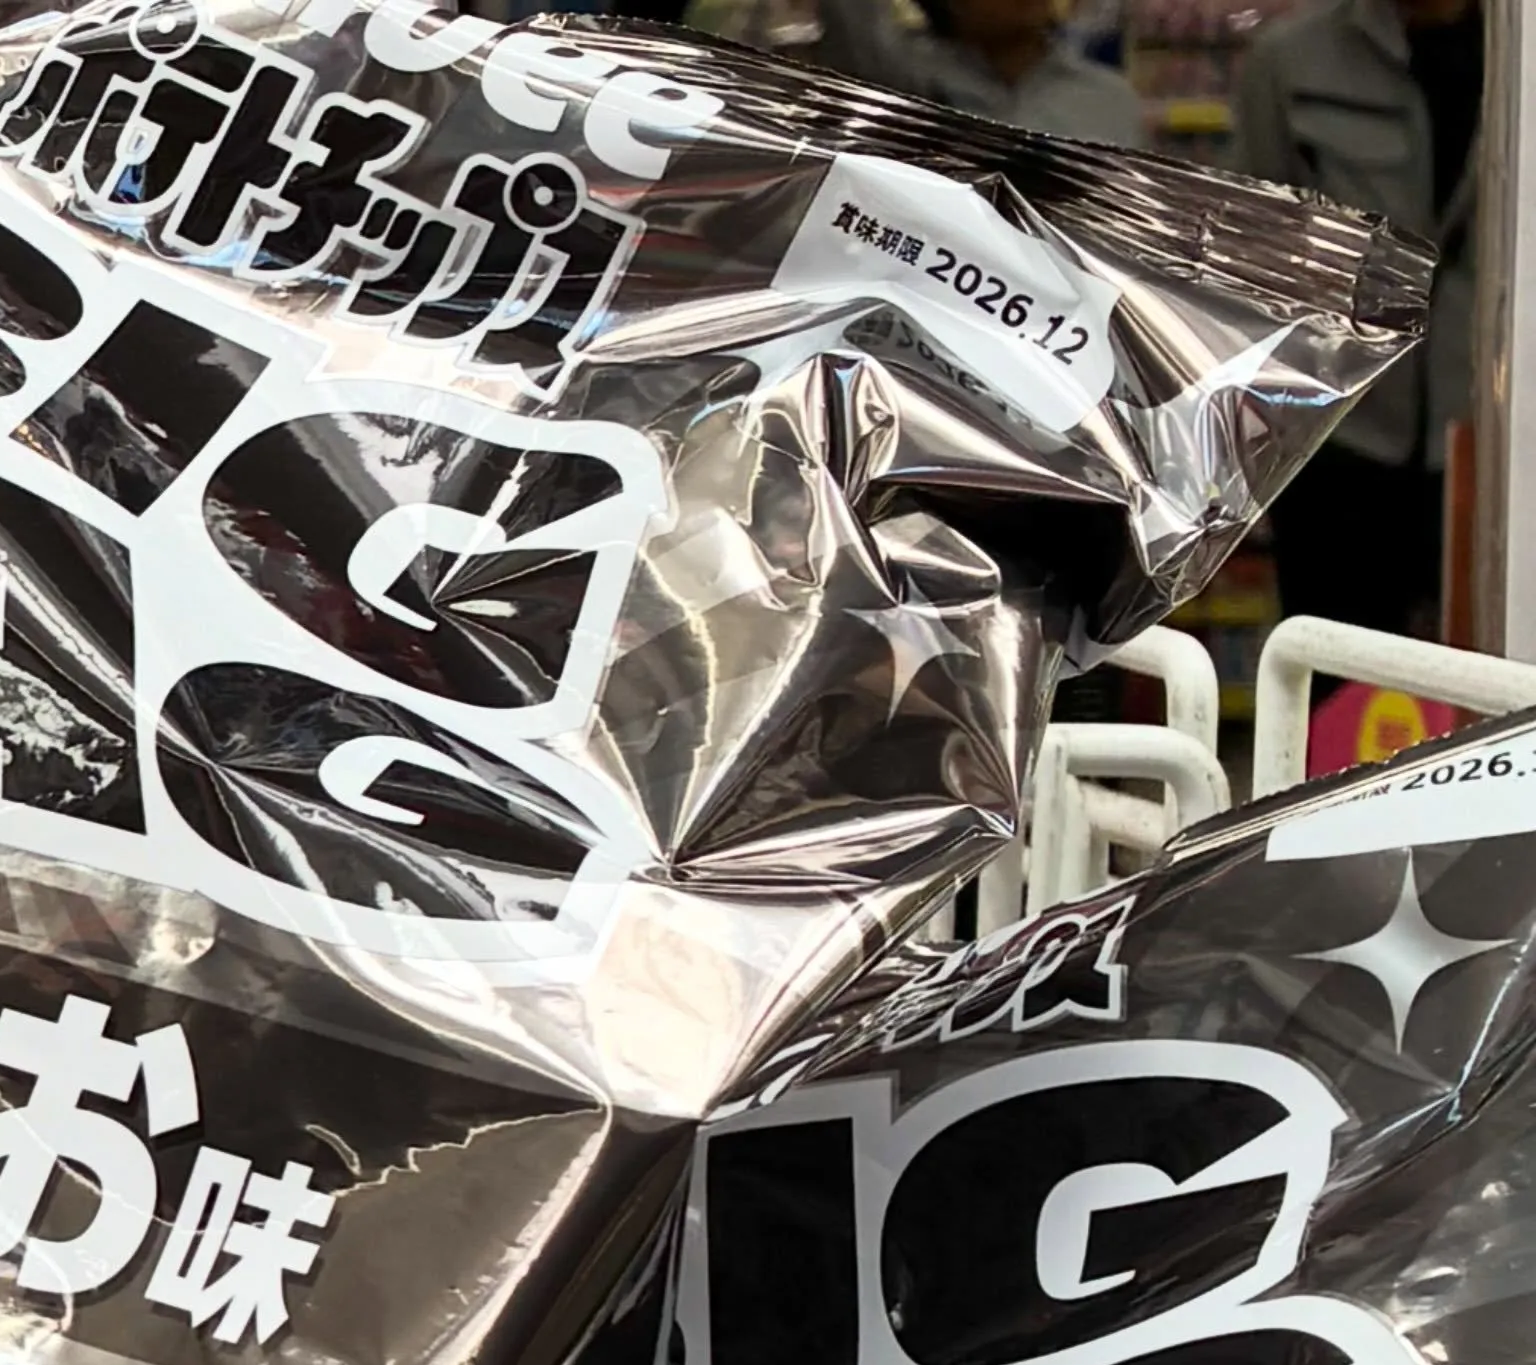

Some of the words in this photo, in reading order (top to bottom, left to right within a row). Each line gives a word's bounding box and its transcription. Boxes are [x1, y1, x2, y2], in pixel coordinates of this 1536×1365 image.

[830, 201, 925, 267] 賞味期限
[925, 247, 1090, 366] 2026.12
[1400, 748, 1536, 792] 2026.
